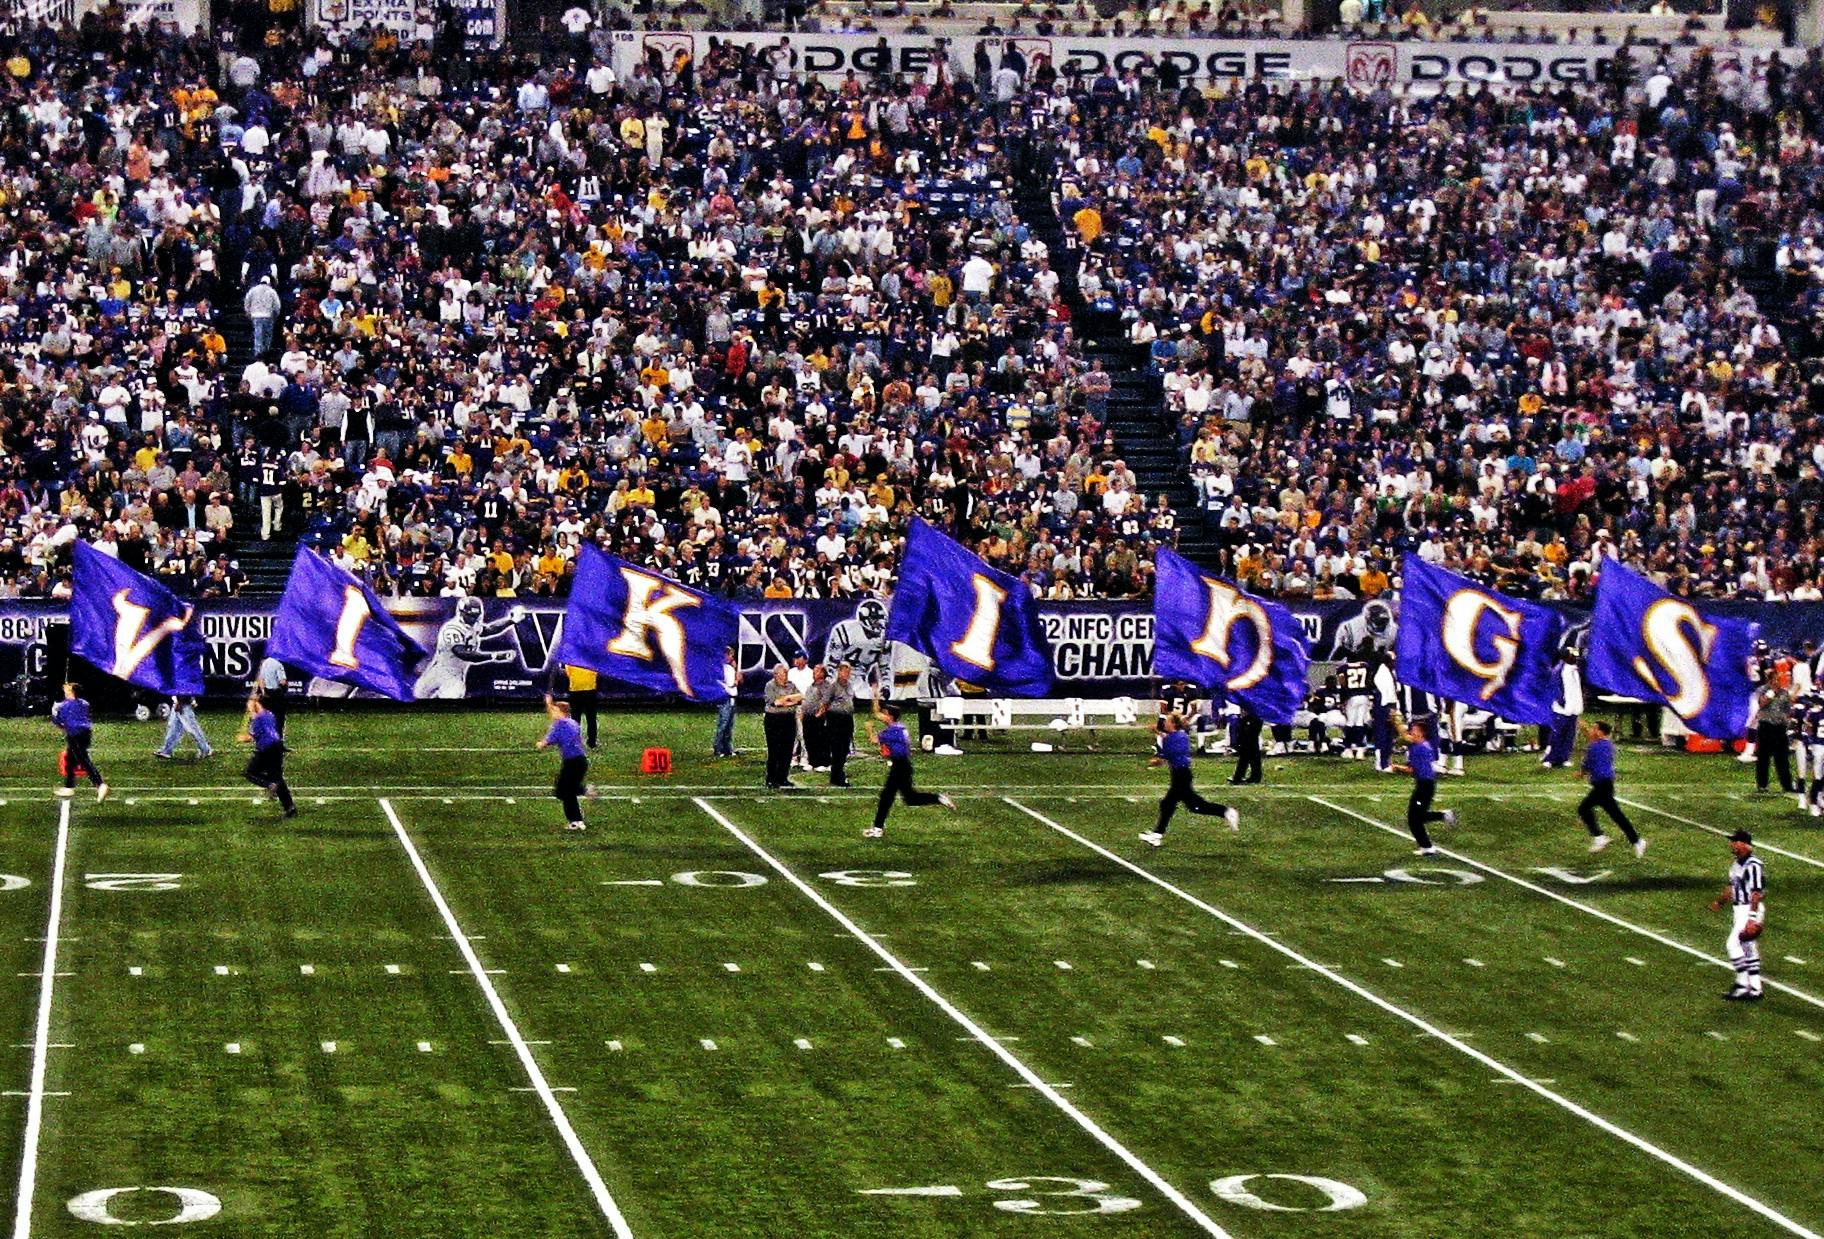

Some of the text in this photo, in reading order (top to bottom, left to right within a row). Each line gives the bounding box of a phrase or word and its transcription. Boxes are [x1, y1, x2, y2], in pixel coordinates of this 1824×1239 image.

[353, 10, 411, 20] POINTS
[718, 45, 932, 72] ODGE
[264, 468, 277, 485] 11
[484, 502, 498, 519] 11
[111, 587, 195, 681] V
[327, 583, 372, 670] I
[606, 566, 704, 699] K
[949, 572, 1009, 672] I
[1068, 617, 1109, 639] NFC
[1441, 588, 1524, 701] G
[1631, 597, 1719, 720] S
[1346, 668, 1367, 688] 27
[647, 751, 668, 770] 30
